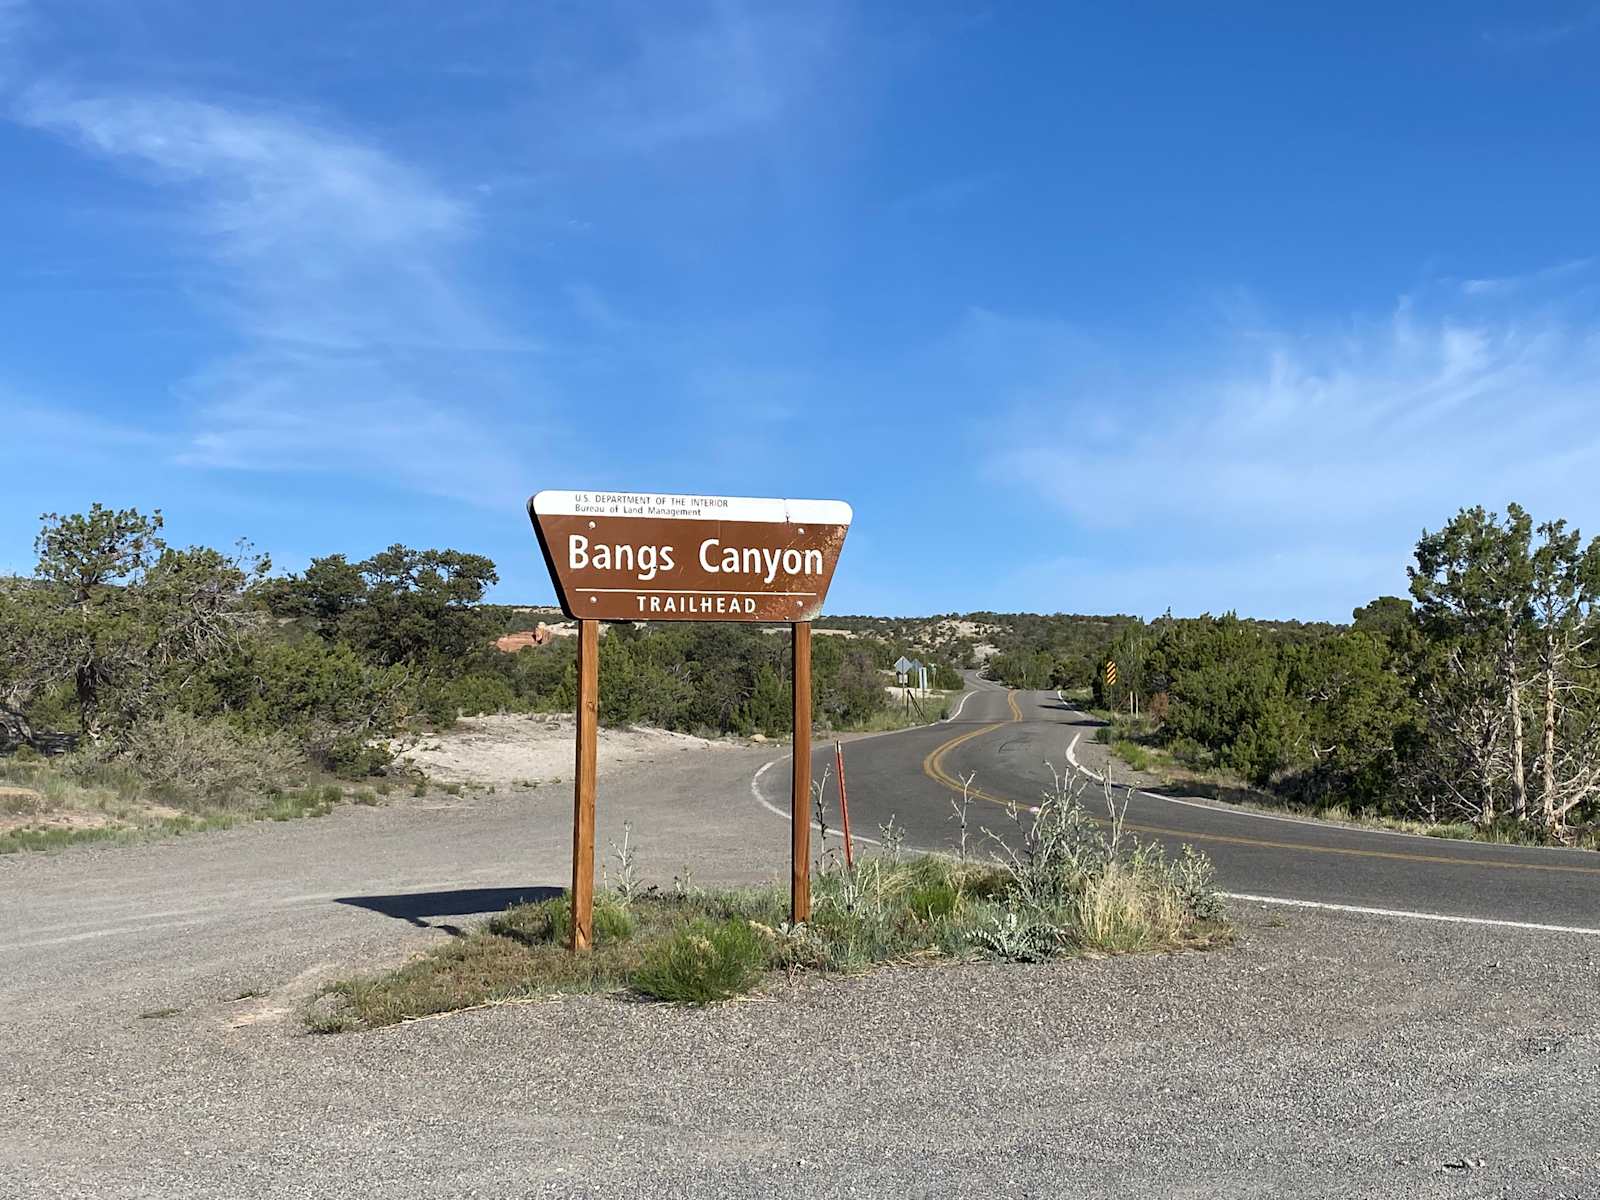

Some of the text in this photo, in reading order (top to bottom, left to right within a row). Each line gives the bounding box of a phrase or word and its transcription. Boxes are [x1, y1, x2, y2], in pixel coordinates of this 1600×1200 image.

[595, 495, 651, 505] DEPARTMENT
[656, 497, 667, 505] OF
[671, 498, 686, 506] THE
[691, 498, 729, 508] INTERIOR
[575, 504, 702, 517] Bureau of Land Management
[569, 534, 823, 584] Bangs Canyon
[637, 595, 757, 614] TRAILHEAD
